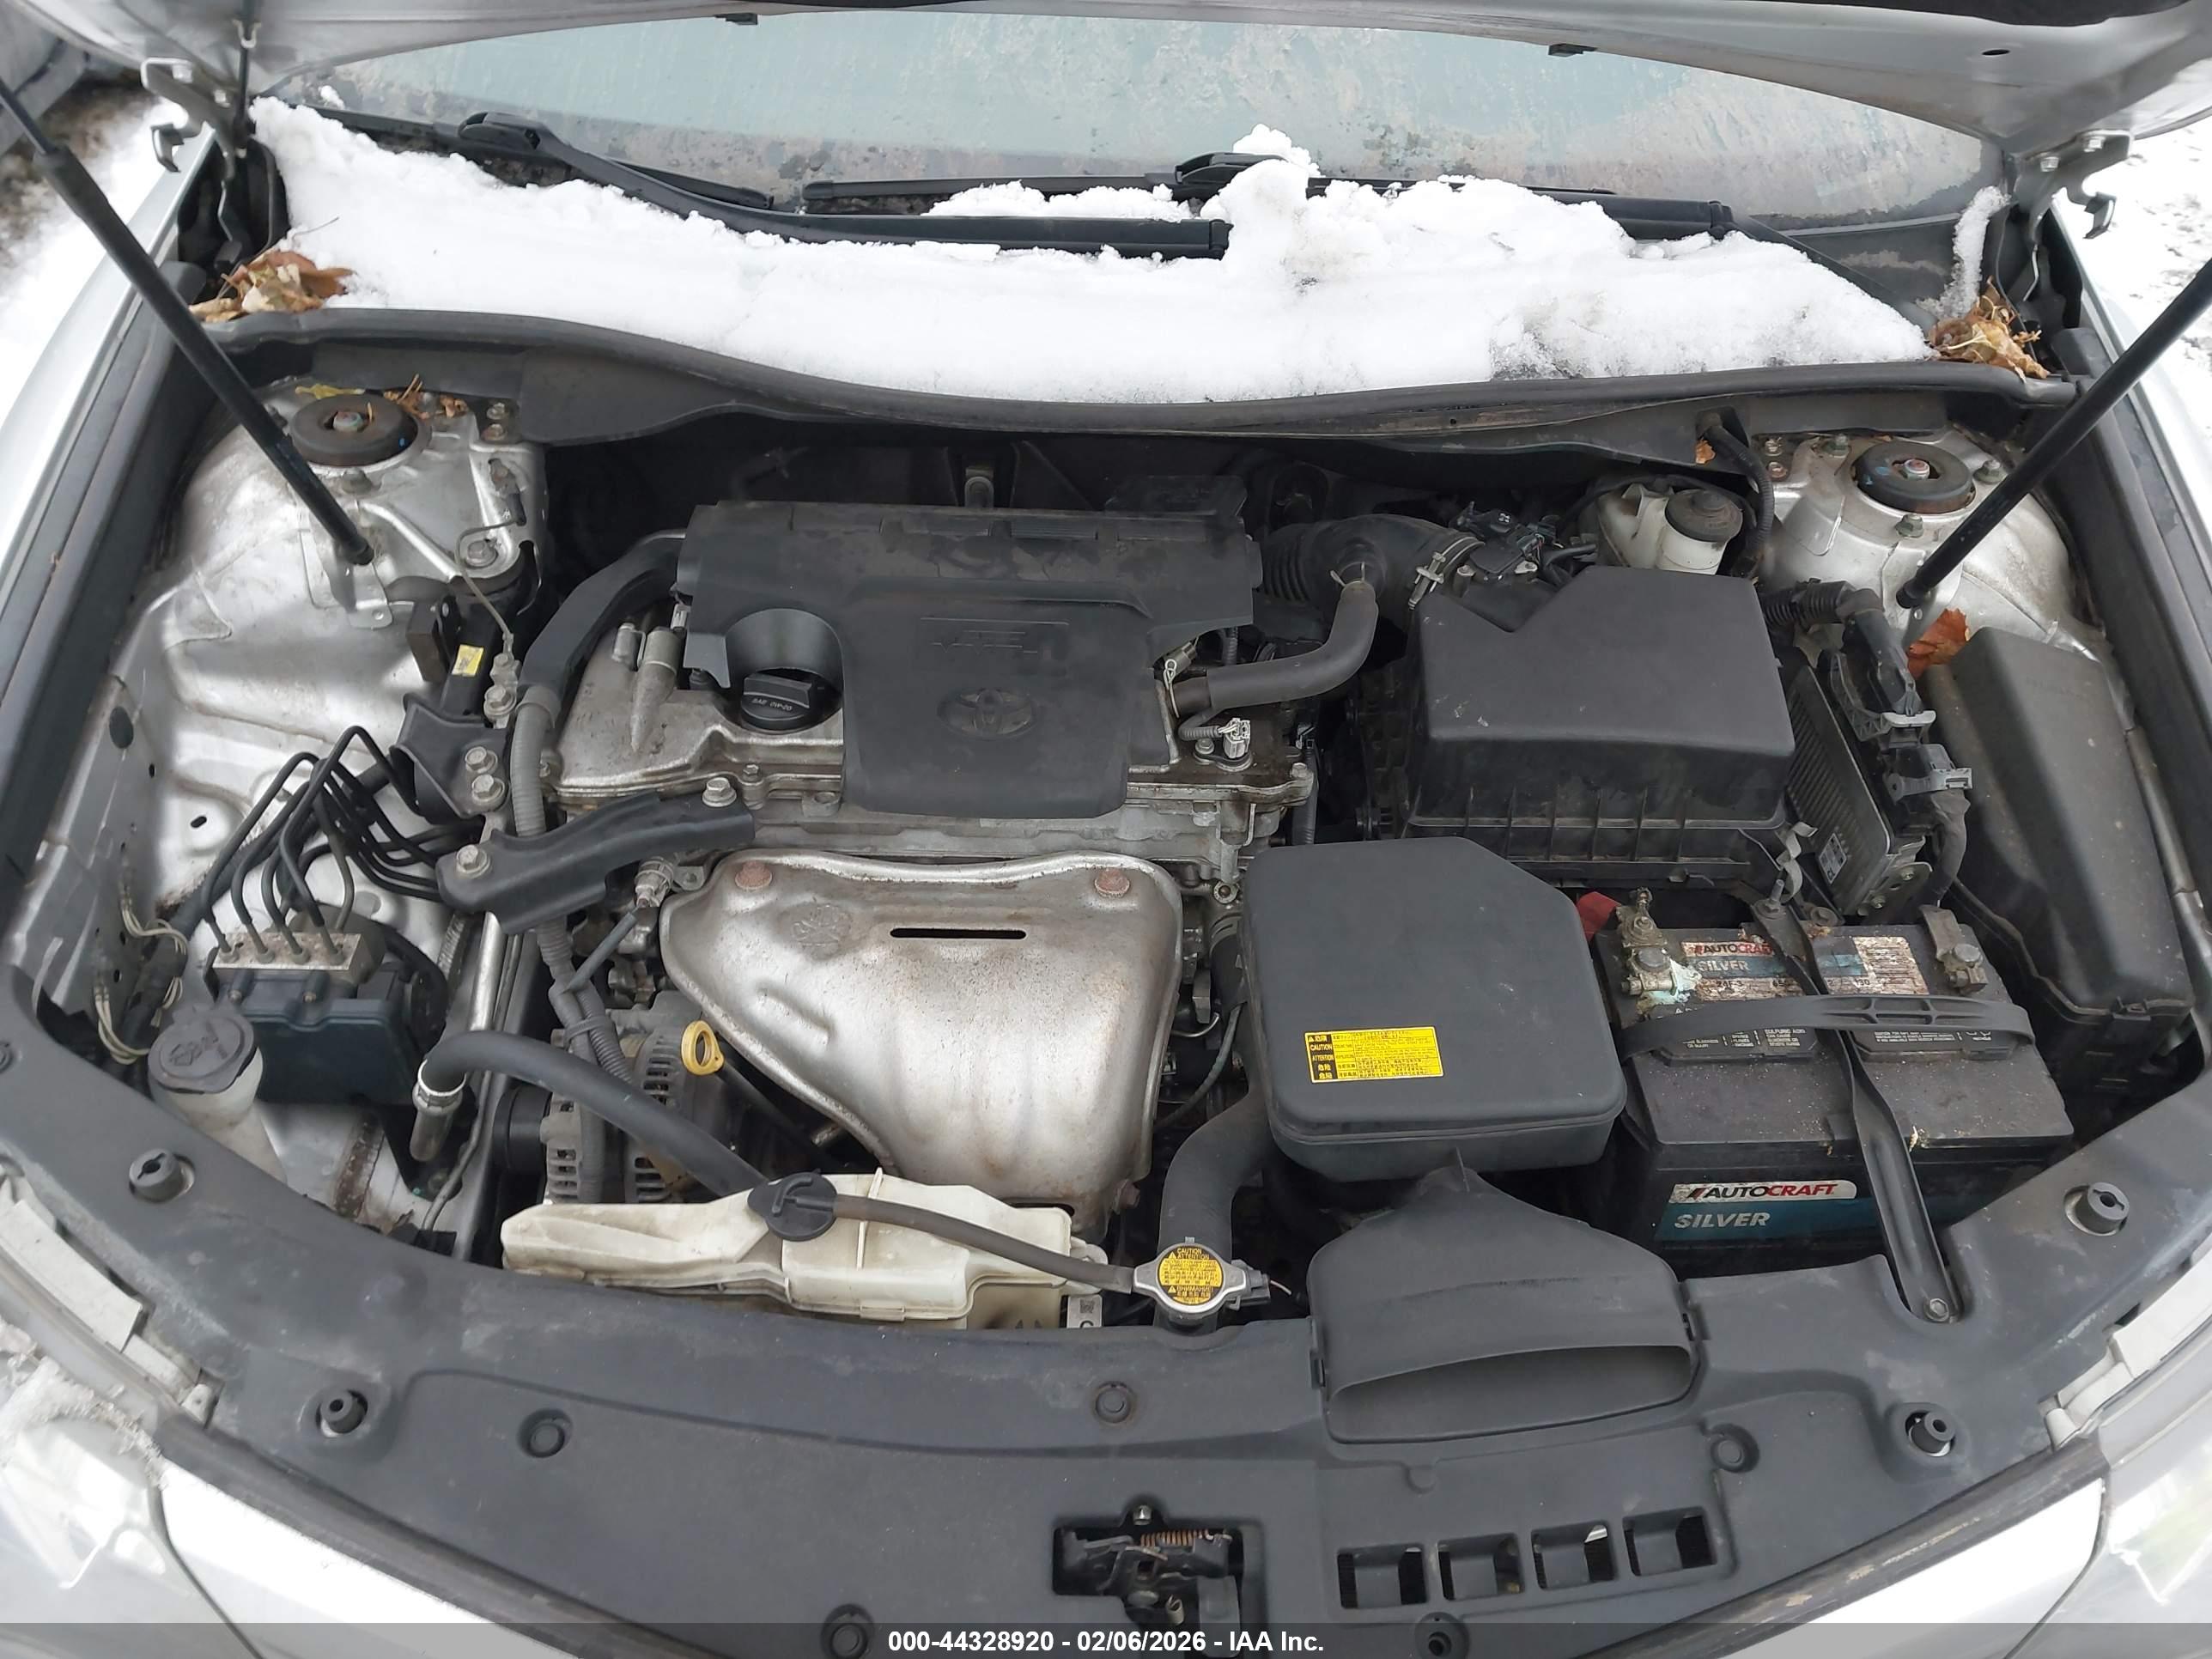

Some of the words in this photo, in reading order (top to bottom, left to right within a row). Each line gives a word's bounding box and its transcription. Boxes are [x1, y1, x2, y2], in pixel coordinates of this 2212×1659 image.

[1697, 959, 1751, 972] SILVER
[1705, 1183, 1838, 1199] AUTOCRAFT
[1674, 1212, 1771, 1229] SILVER
